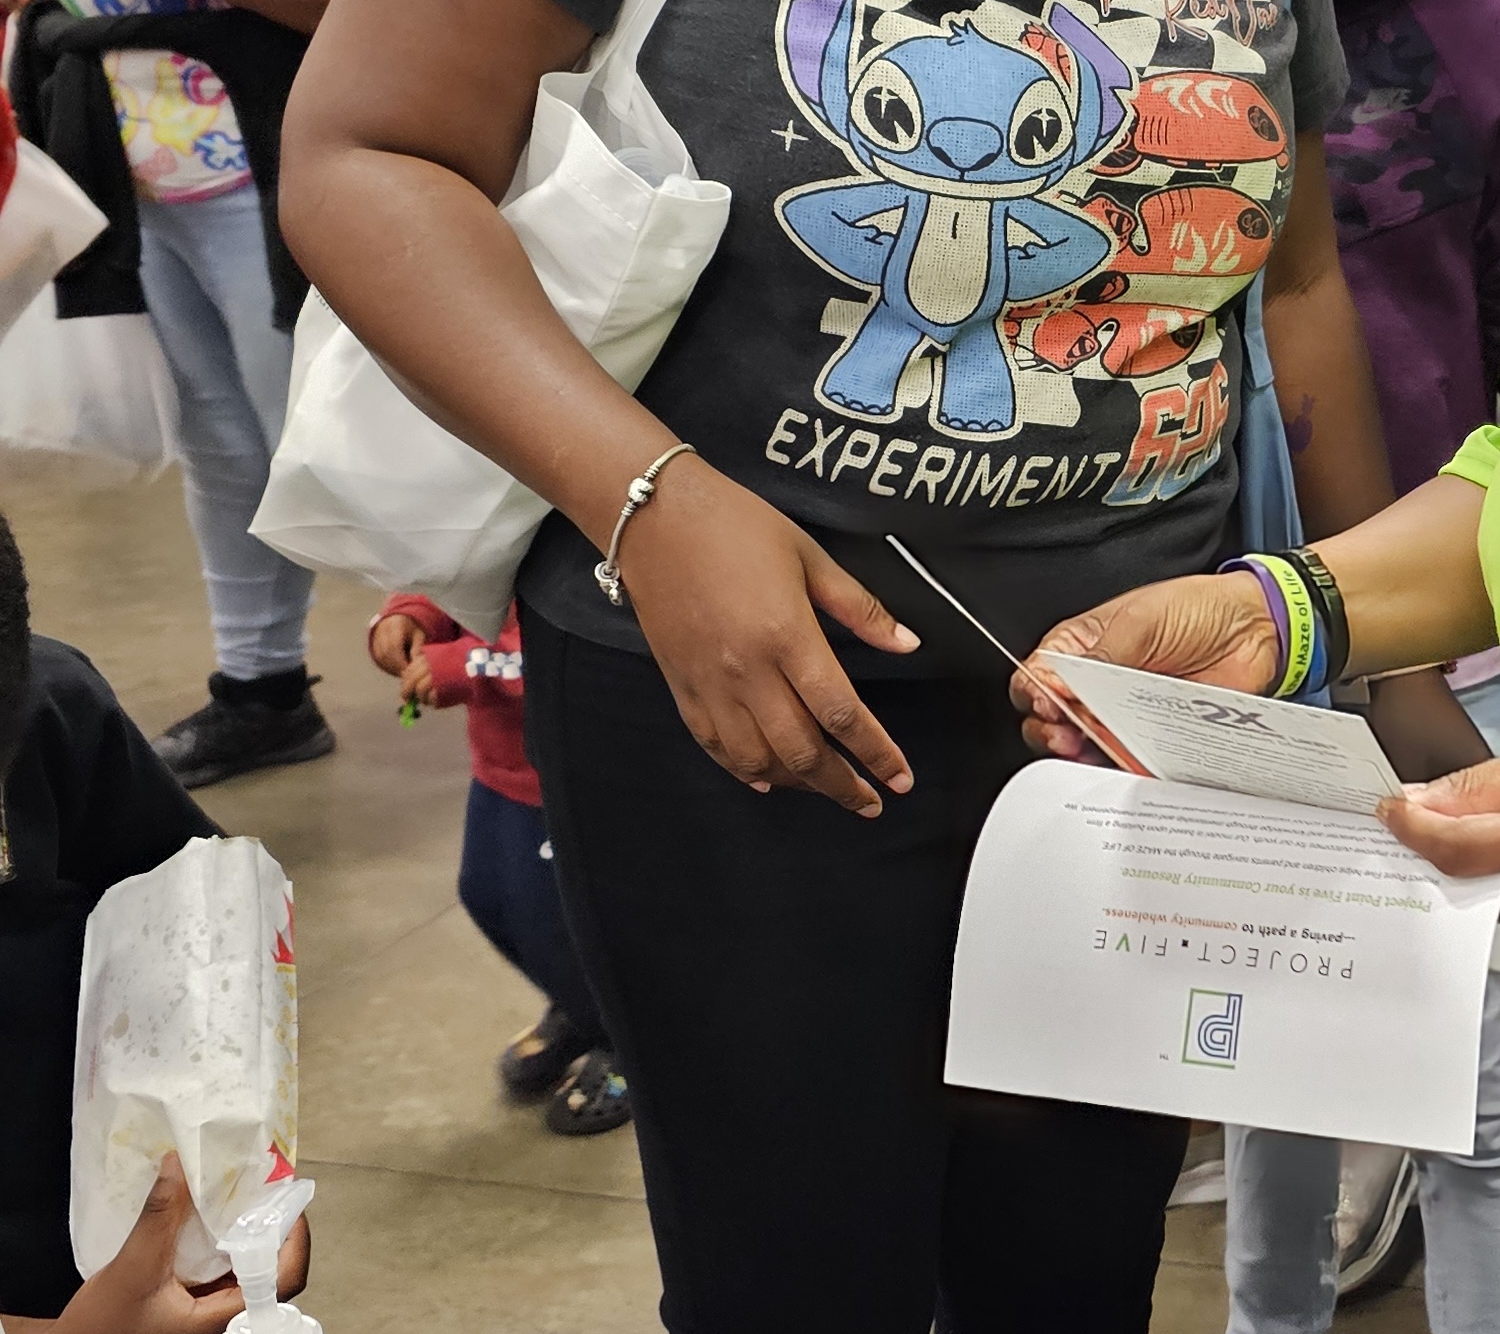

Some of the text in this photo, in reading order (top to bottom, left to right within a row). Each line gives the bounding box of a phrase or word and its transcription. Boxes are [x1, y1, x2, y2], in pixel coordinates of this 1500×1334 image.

[765, 407, 1121, 509] EXPERIMENT
[1283, 570, 1302, 595] Life
[1294, 600, 1309, 618] of
[1296, 622, 1311, 666] Maze
[1184, 873, 1261, 893] Community
[1264, 882, 1295, 895] your
[1298, 887, 1310, 899] is
[1313, 889, 1343, 903] Five
[1346, 892, 1382, 906] Point
[1385, 895, 1432, 913] Project
[1102, 907, 1167, 926] wholeness.
[1170, 912, 1238, 932] community
[1242, 923, 1254, 935] to
[1258, 924, 1287, 939] path
[1289, 929, 1298, 938] a
